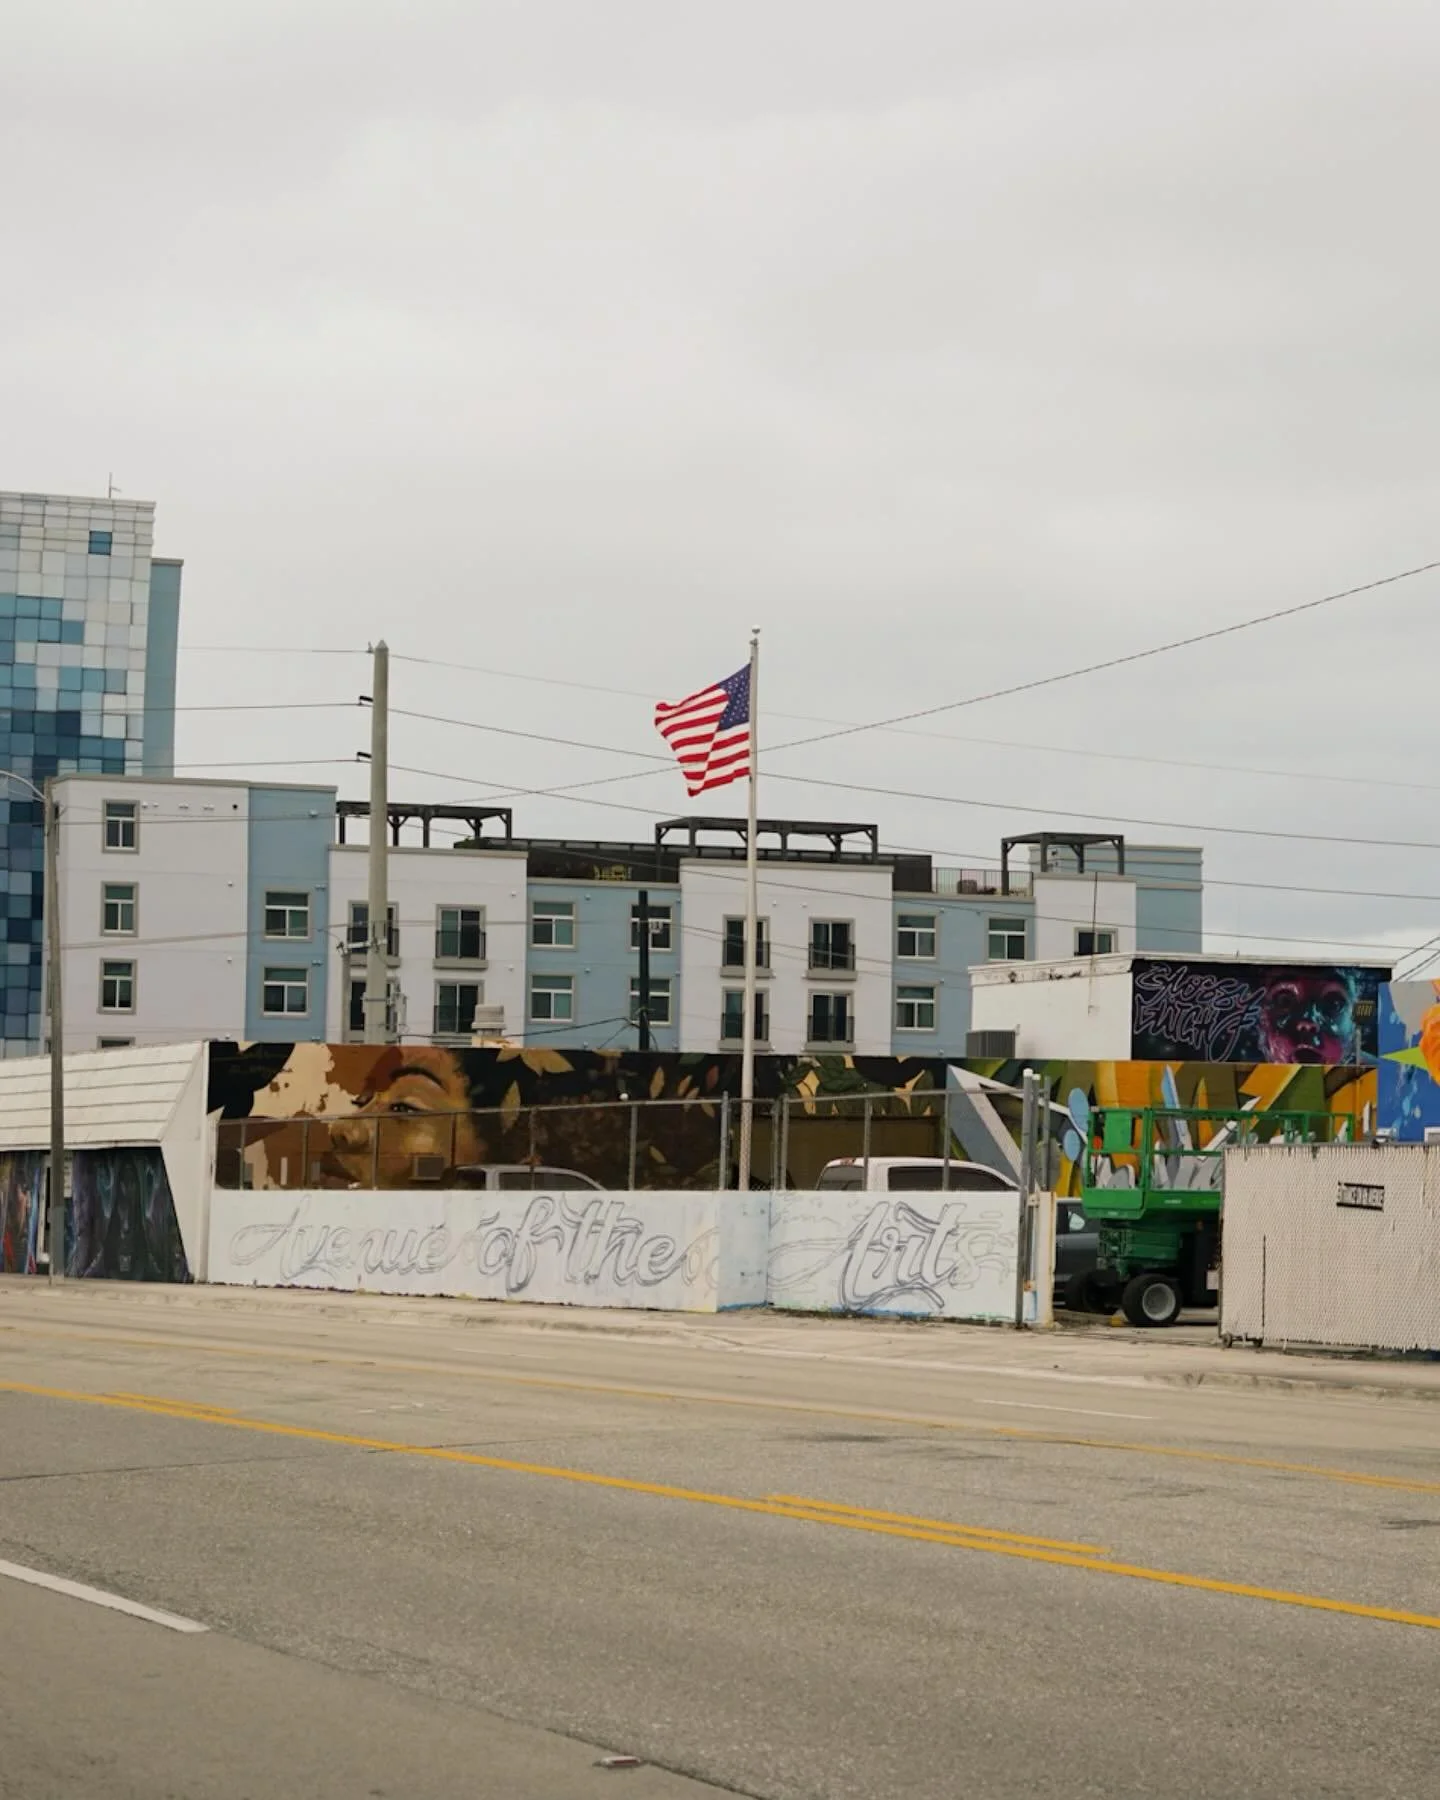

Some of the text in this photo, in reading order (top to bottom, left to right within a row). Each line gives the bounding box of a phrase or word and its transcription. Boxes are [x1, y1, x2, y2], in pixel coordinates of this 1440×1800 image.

[229, 1192, 686, 1296] Avenue of the
